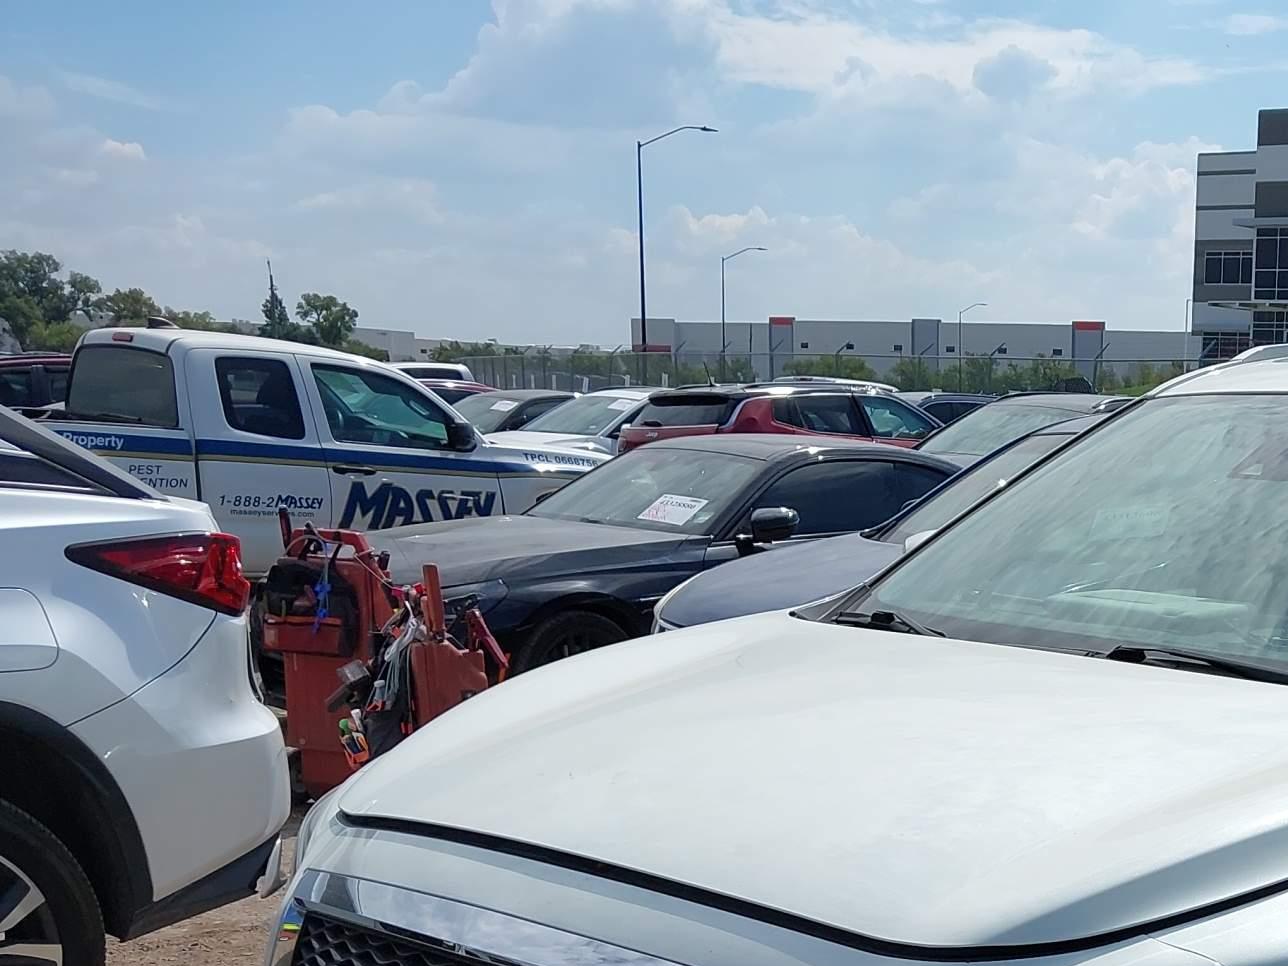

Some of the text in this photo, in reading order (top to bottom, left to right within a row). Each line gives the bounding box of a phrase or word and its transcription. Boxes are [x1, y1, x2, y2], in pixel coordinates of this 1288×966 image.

[62, 432, 124, 449] Property
[523, 452, 553, 463] TPCL
[128, 464, 162, 475] PEST
